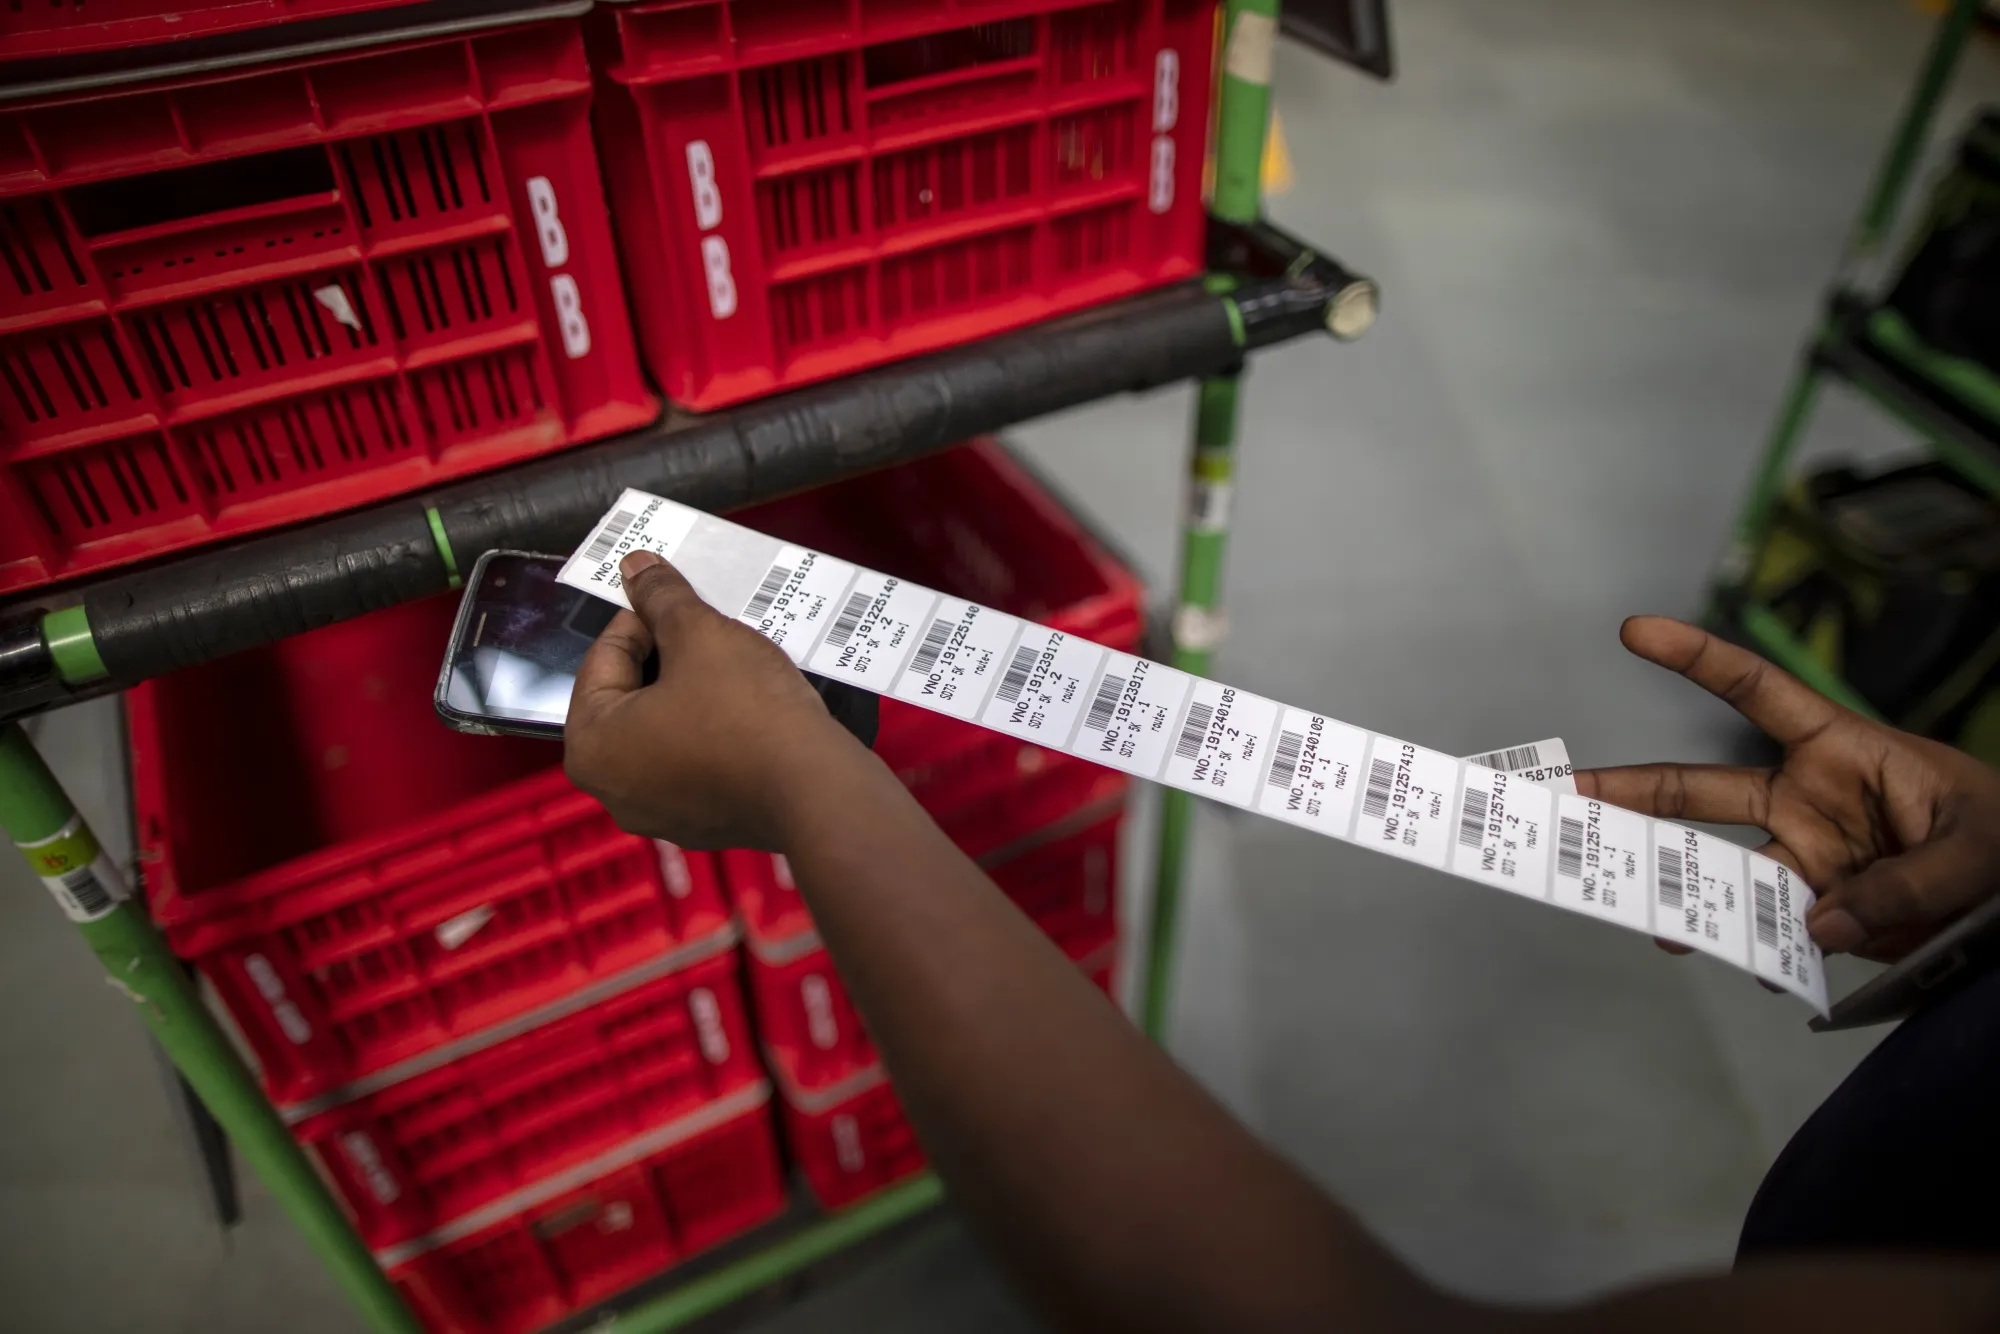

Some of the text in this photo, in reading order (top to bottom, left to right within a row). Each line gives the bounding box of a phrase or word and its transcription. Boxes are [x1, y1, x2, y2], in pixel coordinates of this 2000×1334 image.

[774, 552, 818, 612] 191216154
[799, 591, 810, 602] -1
[806, 595, 826, 622] route-1
[856, 579, 898, 639] 191225140
[880, 616, 893, 630] -2
[889, 622, 909, 648] route-1
[940, 606, 980, 666] 191225140
[964, 646, 976, 657] -1
[974, 648, 994, 676] route-1
[1026, 632, 1064, 694] 191239172
[1050, 672, 1062, 684] -2
[1061, 676, 1080, 704] route-1
[1116, 660, 1150, 722] 191239172
[1138, 702, 1150, 713] -1
[1151, 705, 1168, 732] route-1
[1206, 688, 1236, 750] 191240105
[1227, 728, 1240, 742] -2
[1242, 734, 1258, 761] route-1
[1298, 716, 1324, 780] 191240105
[1319, 758, 1330, 770] -1
[1333, 762, 1348, 790] route-1
[1392, 744, 1414, 810] 191257413
[1412, 786, 1424, 800] -3
[1428, 790, 1442, 820] route-1
[1488, 774, 1506, 838] 191257413
[1506, 814, 1519, 830] -2
[1586, 802, 1600, 868] 191257413
[1604, 846, 1616, 858] -1
[1685, 830, 1700, 900] 191287184
[1703, 876, 1716, 890] -1
[1777, 866, 1792, 941] 191308629
